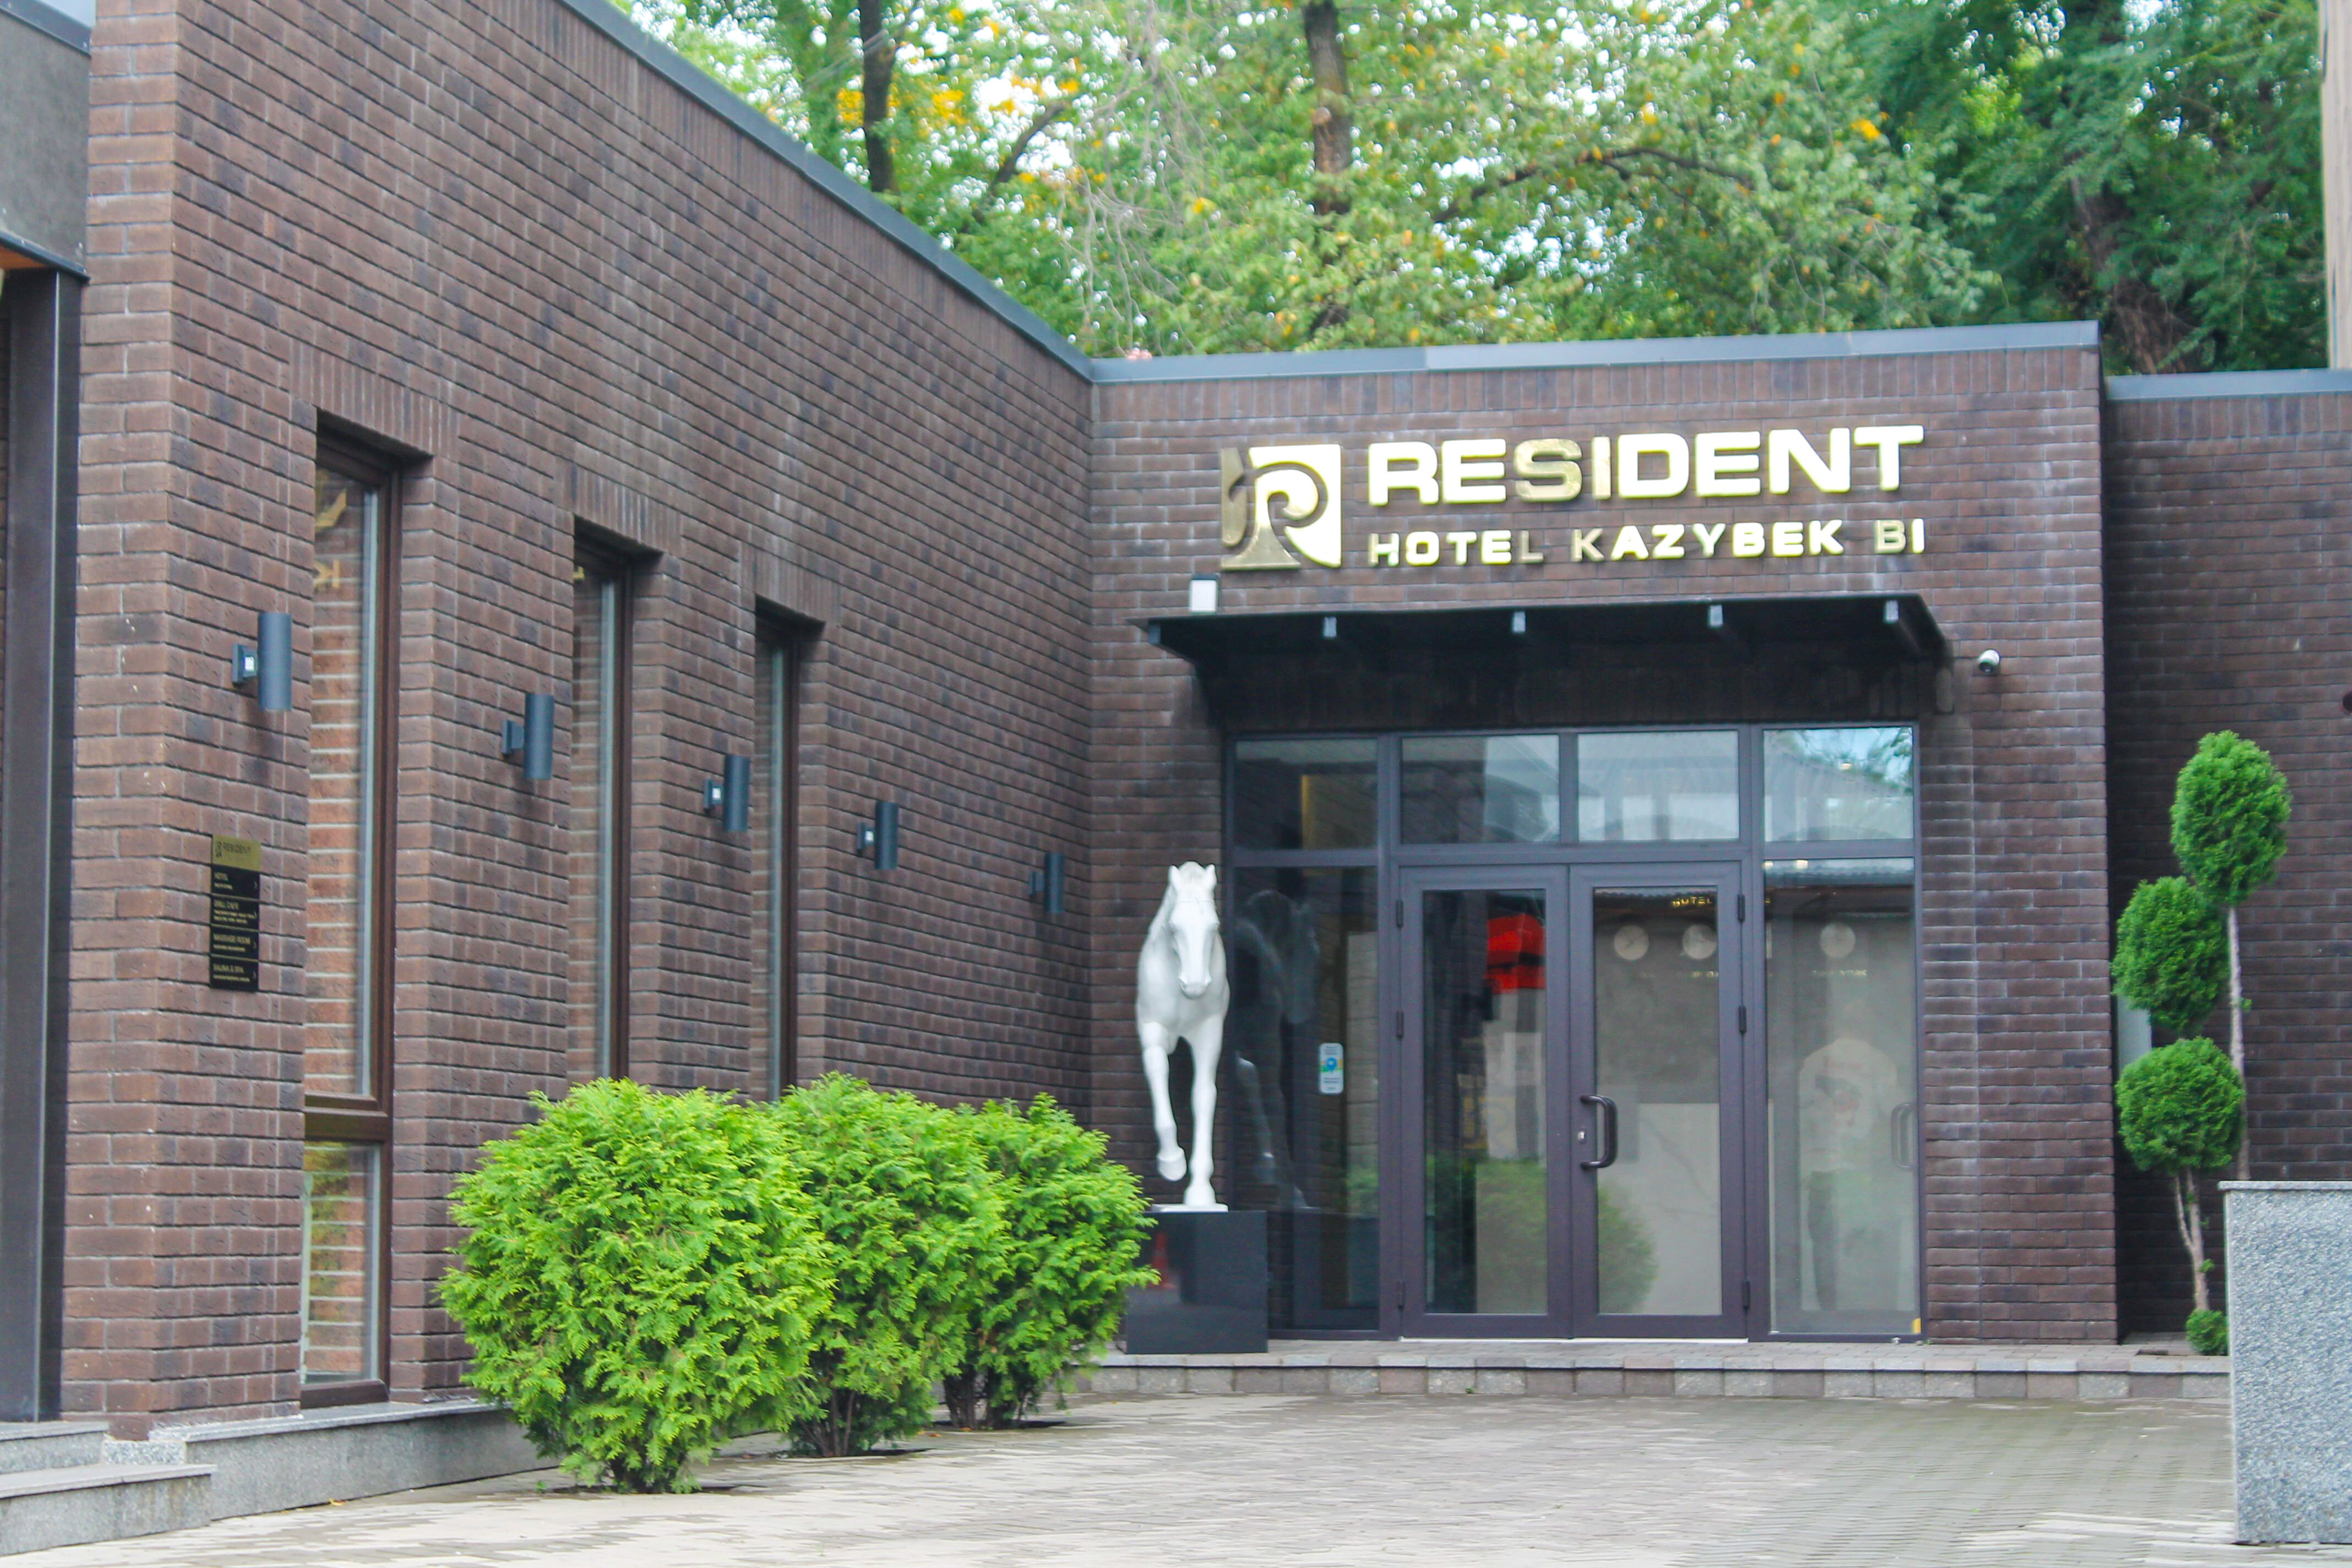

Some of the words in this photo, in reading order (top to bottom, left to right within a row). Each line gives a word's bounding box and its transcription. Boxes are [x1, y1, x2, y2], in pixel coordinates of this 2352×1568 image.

[1368, 424, 1925, 507] RESIDENT
[1368, 529, 1544, 567] HOTEL
[1570, 518, 1844, 562] KAZYBEK
[1874, 518, 1925, 555] BI
